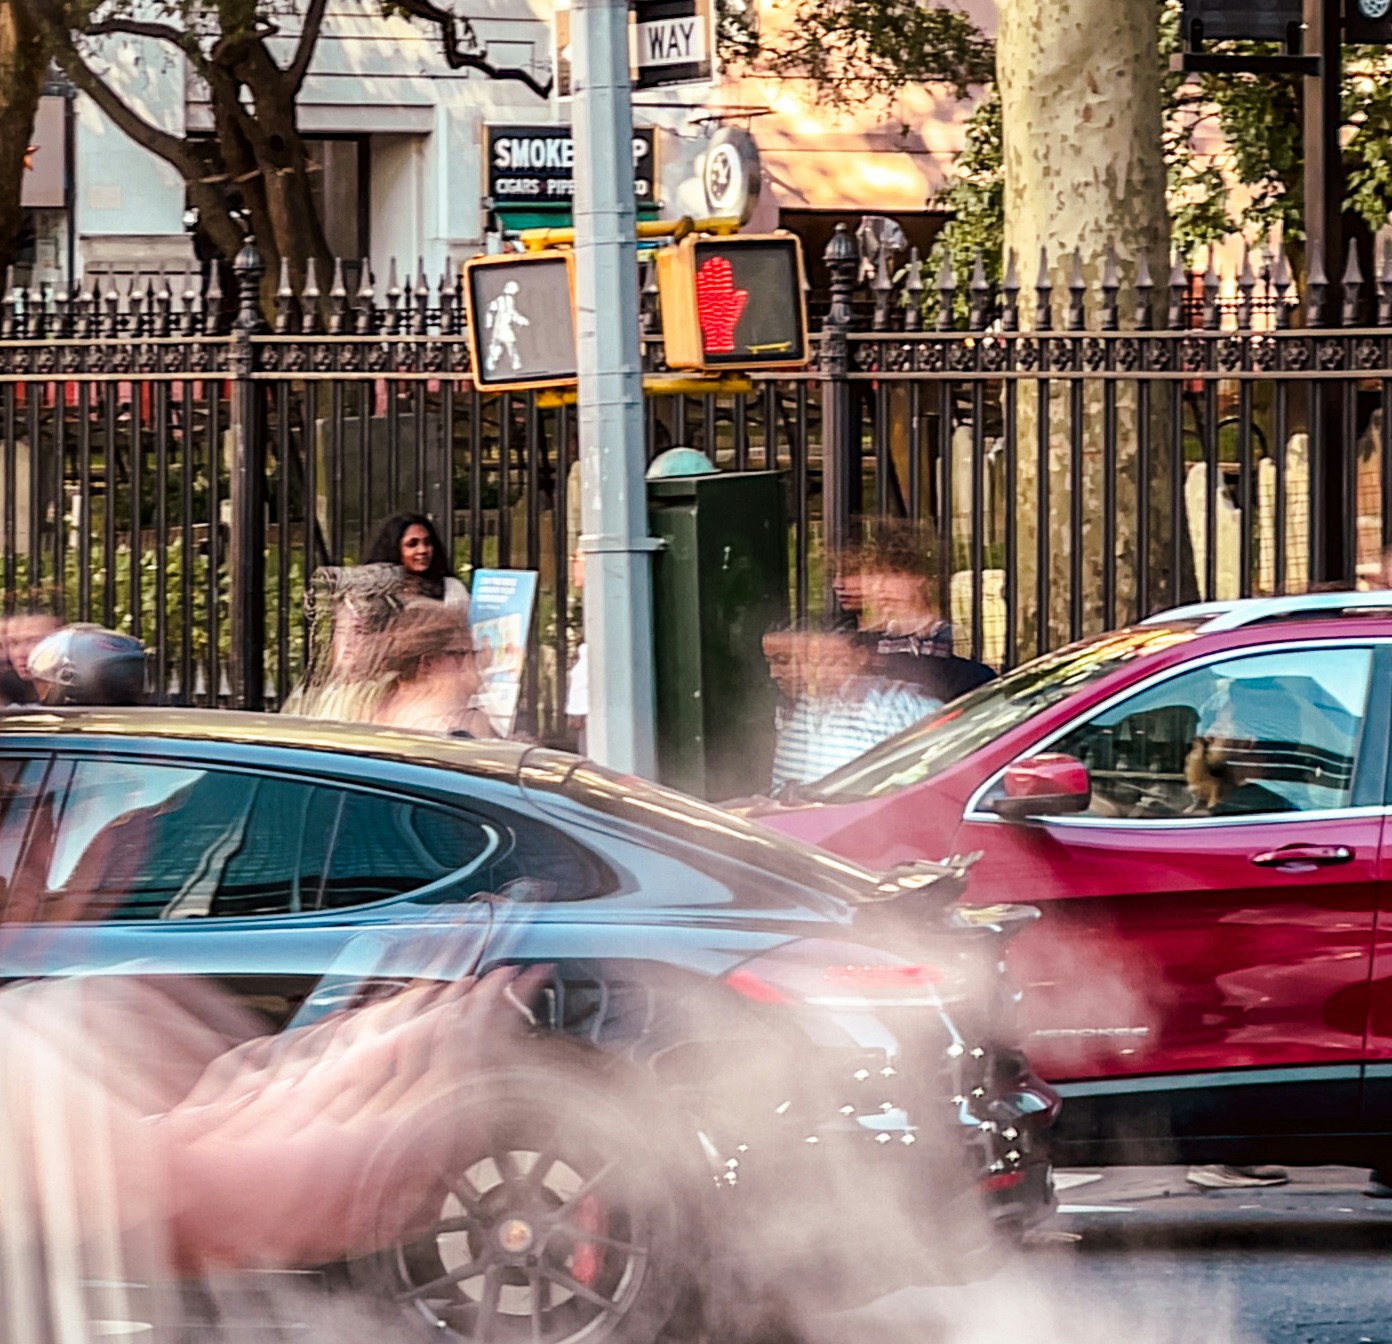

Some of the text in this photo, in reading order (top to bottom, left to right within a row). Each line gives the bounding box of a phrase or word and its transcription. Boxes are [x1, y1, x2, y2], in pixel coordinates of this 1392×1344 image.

[648, 22, 694, 59] WAY
[494, 138, 575, 168] SMOKE
[495, 178, 576, 196] CIGARS PIPE
